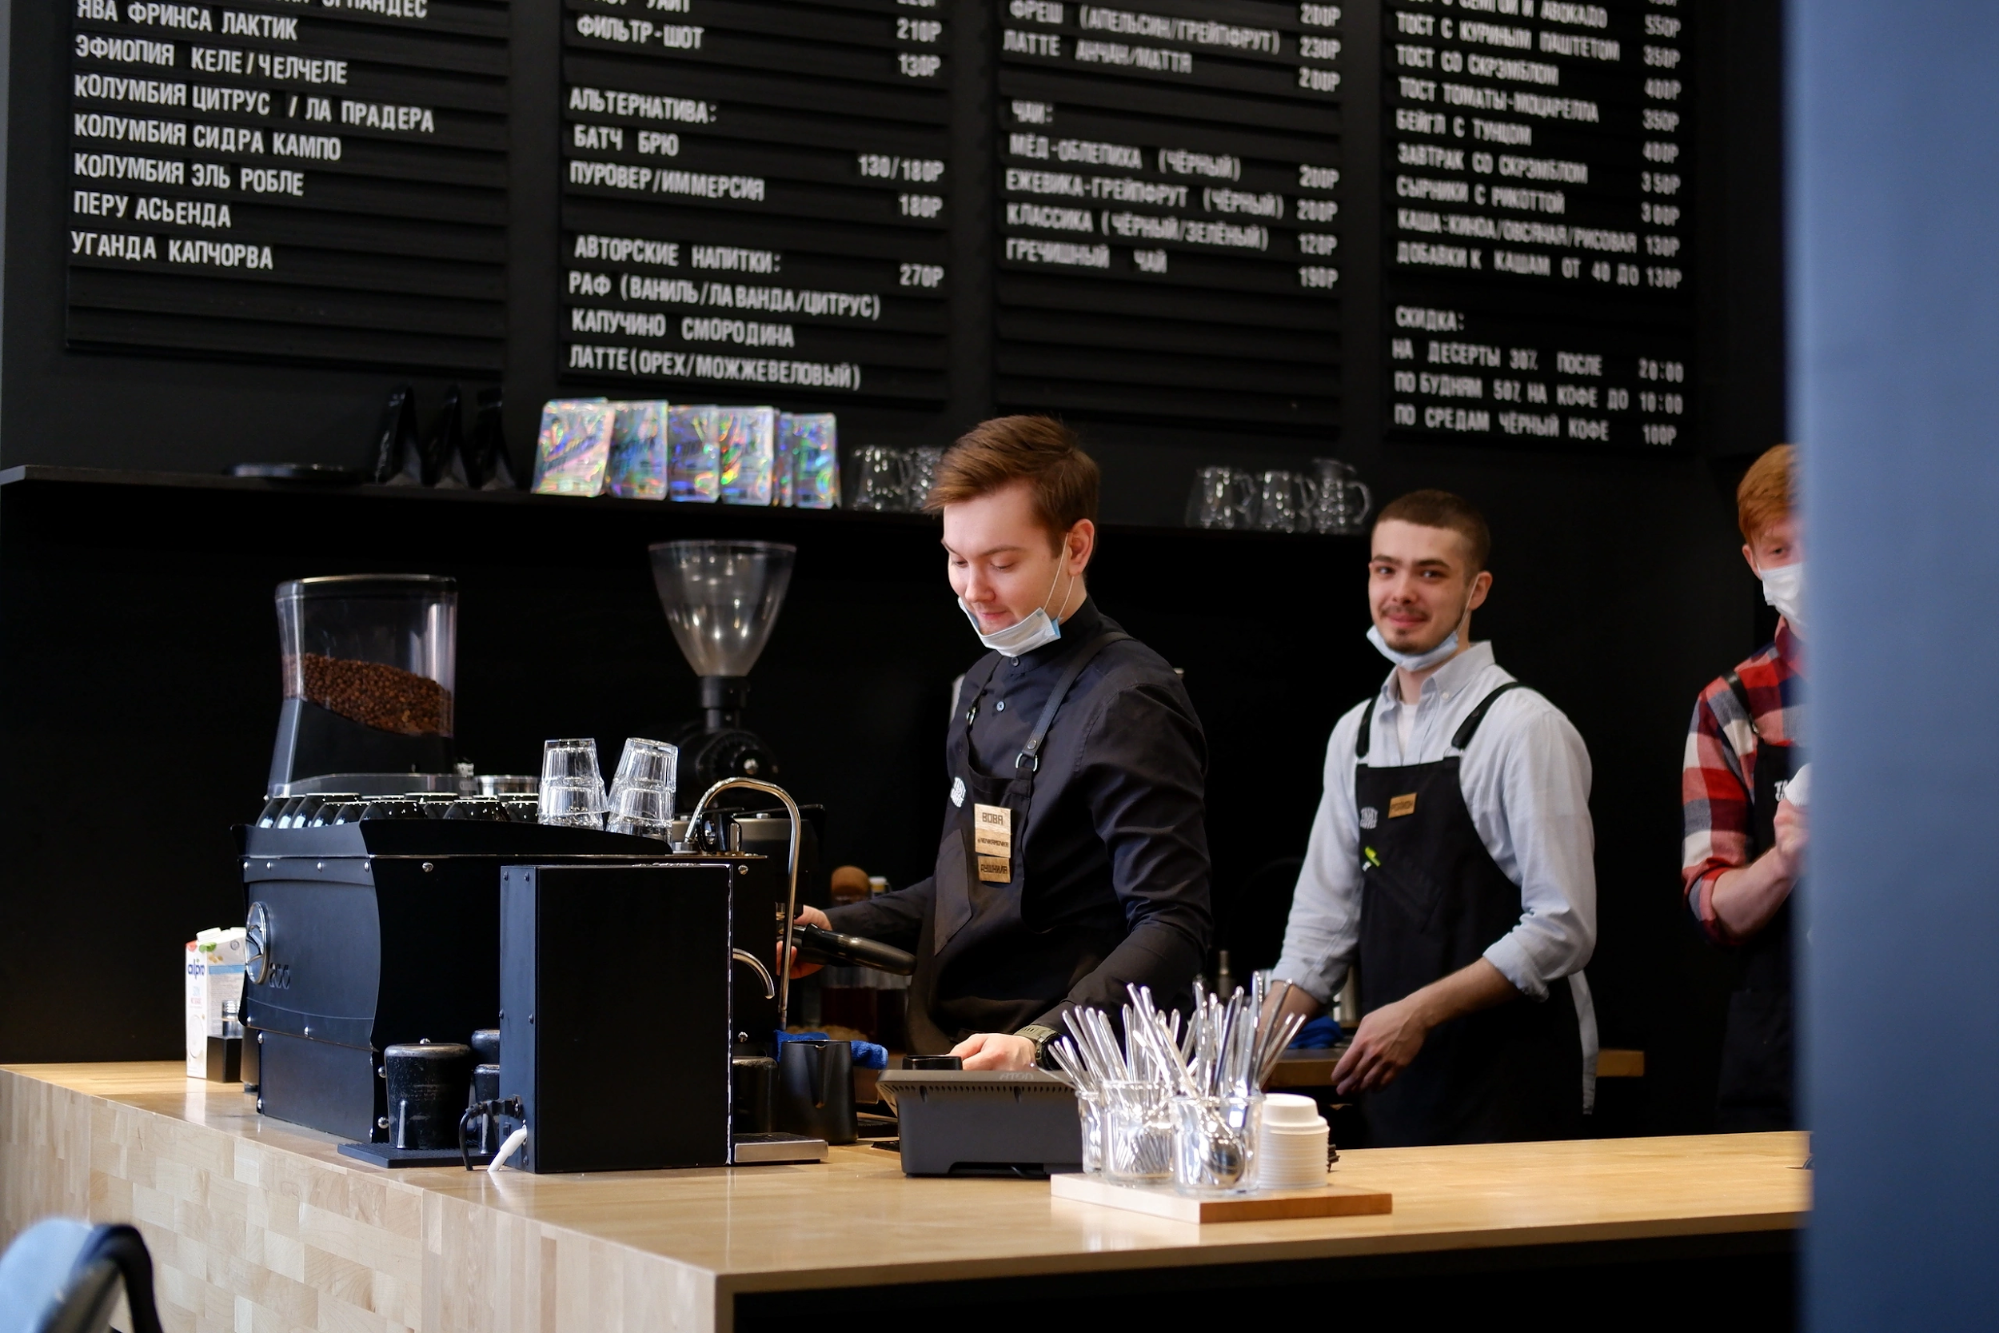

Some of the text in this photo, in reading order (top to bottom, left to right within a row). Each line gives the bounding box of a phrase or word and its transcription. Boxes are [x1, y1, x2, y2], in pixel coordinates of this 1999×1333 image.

[78, 0, 297, 40] ЯВА ФРИНСА ЛАКТИК
[1010, 0, 1063, 23] ФРЕШ
[577, 15, 704, 48] ФИЛЬТР-ШОТ
[1004, 30, 1059, 56] ЛАТТЕ
[1396, 12, 1435, 35] ТОСТ
[1441, 18, 1452, 39] С
[1460, 22, 1531, 49] КУРИНЫМ
[1540, 32, 1619, 60] ПАШТЕТОМ
[76, 35, 347, 84] ЭФИОПИЯ КЕЛЕ/ЧЕЛЧЕЛЕ
[1396, 45, 1434, 68] ТОСТ
[1441, 51, 1462, 72] СО
[75, 74, 186, 106] КОЛУМБИЯ
[193, 86, 270, 115] ЦИТРУС
[306, 98, 331, 122] ЛА
[342, 101, 434, 132] ПРАДЕРА
[570, 88, 716, 123] АЛЬТЕРНАТИВА:
[1399, 77, 1436, 101] ТОСТ
[75, 114, 341, 160] КОЛУМБИЯ СИДРА КАМПО
[575, 125, 622, 150] БАТЧ
[638, 131, 678, 156] БРЮ
[1397, 109, 1445, 133] БЕЙГЛ
[1453, 117, 1464, 137] С
[1473, 119, 1531, 145] ТУНЦОМ
[75, 153, 303, 196] КОЛУМБИЯ ЭЛЬ РОБЛЕ
[1398, 143, 1464, 170] ЗАВТРАК
[1472, 152, 1493, 174] СО
[570, 161, 764, 201] ПУРОВЕР/ИММЕРСИЯ
[1397, 176, 1468, 202] СЫРНИКИ
[1475, 184, 1485, 205] С
[74, 191, 231, 228] ПЕРУ АСЬЕНДА
[1007, 203, 1093, 232] КЛАССИКА
[71, 231, 273, 269] УГАНДА КАПЧОРВА
[575, 235, 678, 266] АВТОРСКИЕ
[692, 247, 780, 273] НАПИТКИ:
[1007, 238, 1109, 268] ГРЕЧИШНЫЙ
[1397, 242, 1467, 267] ДОБАВКИ
[1471, 250, 1481, 269] К
[1494, 251, 1550, 275] КАШАМ
[1562, 257, 1580, 278] ОТ
[1592, 262, 1610, 282] 40
[1617, 264, 1639, 285] ДО
[569, 271, 611, 296] РАФ
[573, 309, 794, 347] КАПУЧИНО СМОРОДИНА
[1396, 306, 1463, 331] СКИДКА:
[1392, 339, 1413, 359] НА
[1428, 341, 1500, 367] ДЕСЕРТЫ
[1557, 352, 1601, 376] ПОСЛЕ
[1639, 359, 1683, 382] 20:00
[1395, 371, 1416, 392] ПО
[1420, 373, 1482, 398] БУДНЯМ
[1528, 384, 1547, 403] НА
[1557, 385, 1597, 407] КОФЕ
[1607, 389, 1628, 410] ДО
[1640, 392, 1683, 414] 10:00
[1395, 404, 1415, 425] ПО
[1425, 407, 1489, 431] СРЕДАМ
[1569, 418, 1608, 441] КОФЕ
[187, 959, 205, 979] alpro
